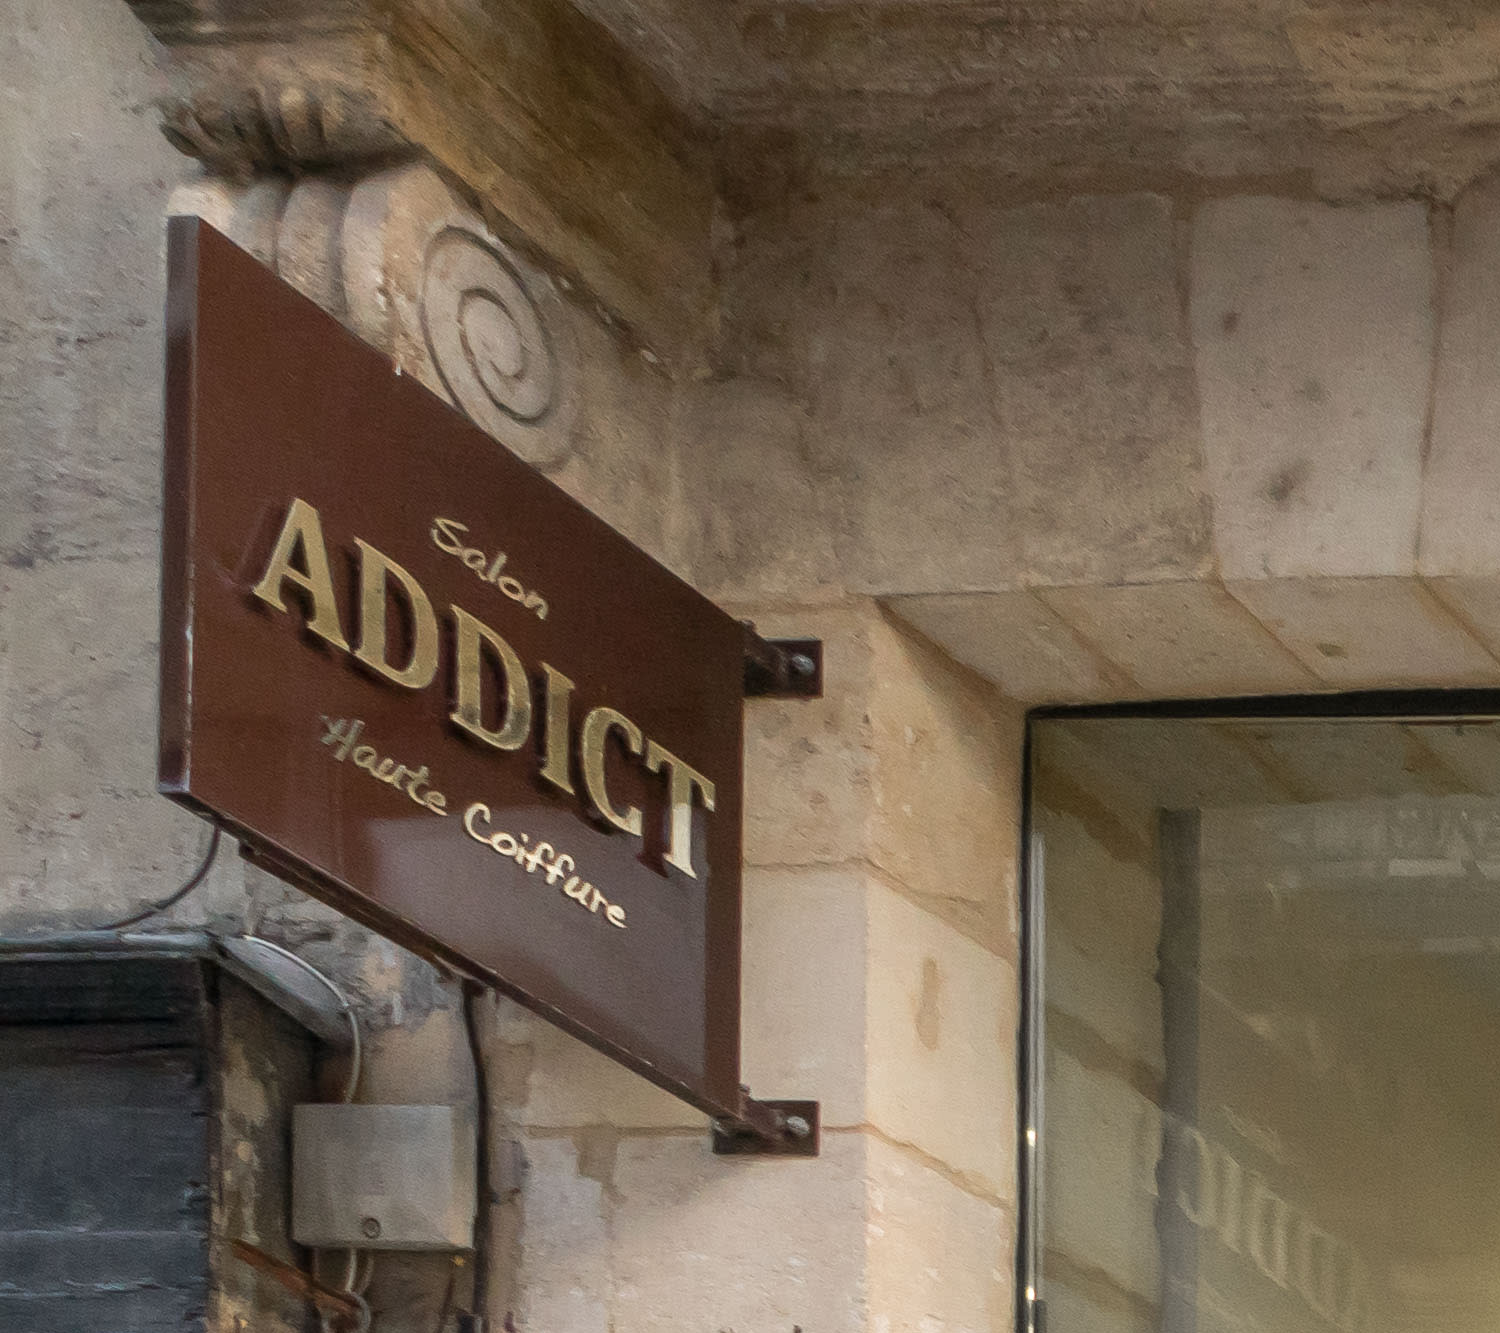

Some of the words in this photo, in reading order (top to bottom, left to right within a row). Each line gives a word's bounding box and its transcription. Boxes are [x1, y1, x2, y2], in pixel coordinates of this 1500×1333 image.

[431, 518, 549, 620] Salon
[253, 497, 716, 879] ADDICT
[320, 714, 448, 816] Haute
[463, 803, 628, 928] Coiffure
